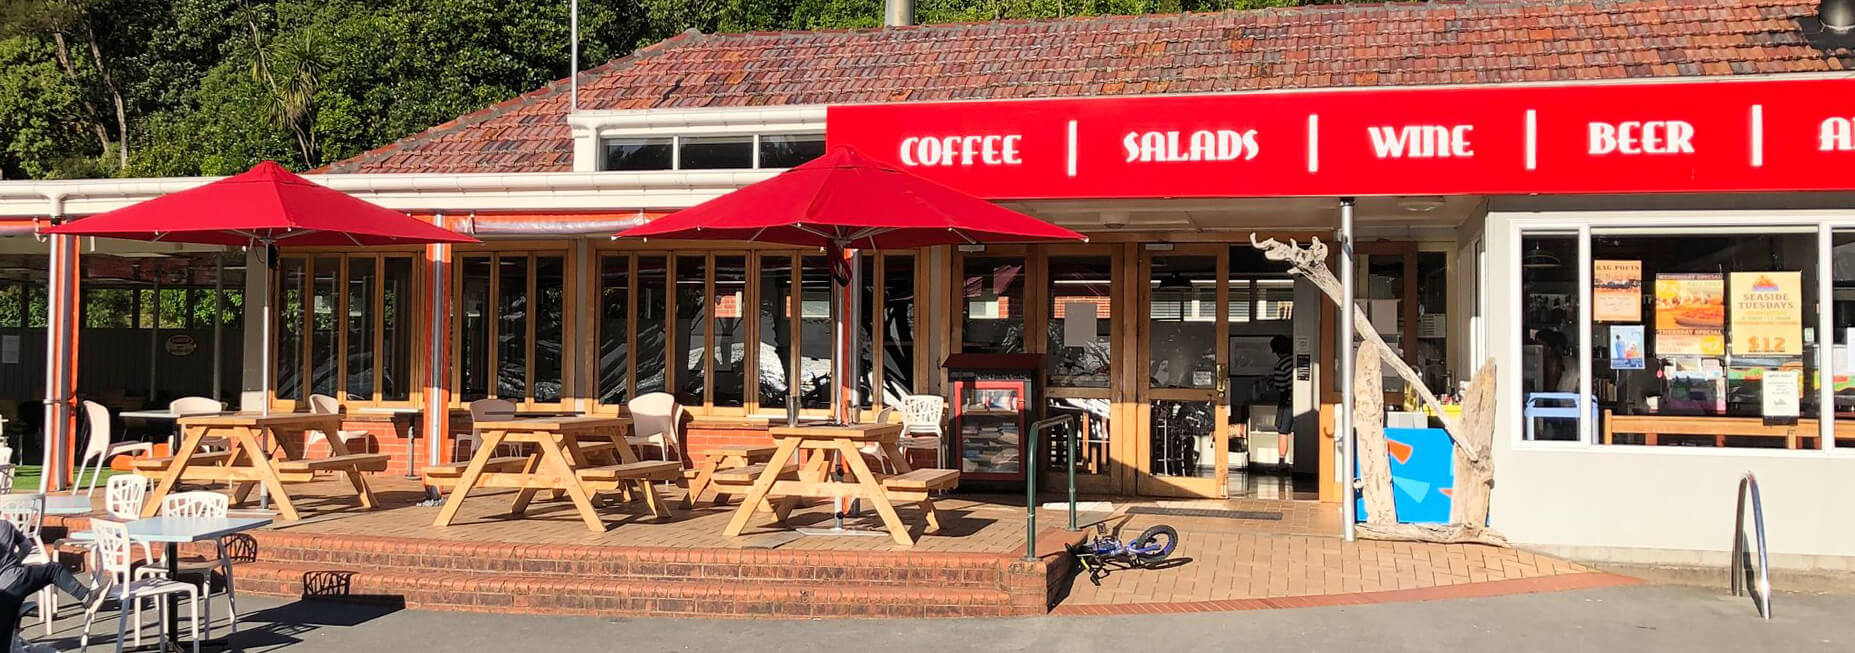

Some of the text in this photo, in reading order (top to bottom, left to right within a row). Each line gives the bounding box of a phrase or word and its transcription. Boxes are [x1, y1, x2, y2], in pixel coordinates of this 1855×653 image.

[900, 116, 1855, 166] COFFEE SALADS WINE BEER A
[1743, 293, 1790, 301] SEASIDE
[1738, 301, 1794, 310] TUESDAYS
[1748, 335, 1786, 352] $12
